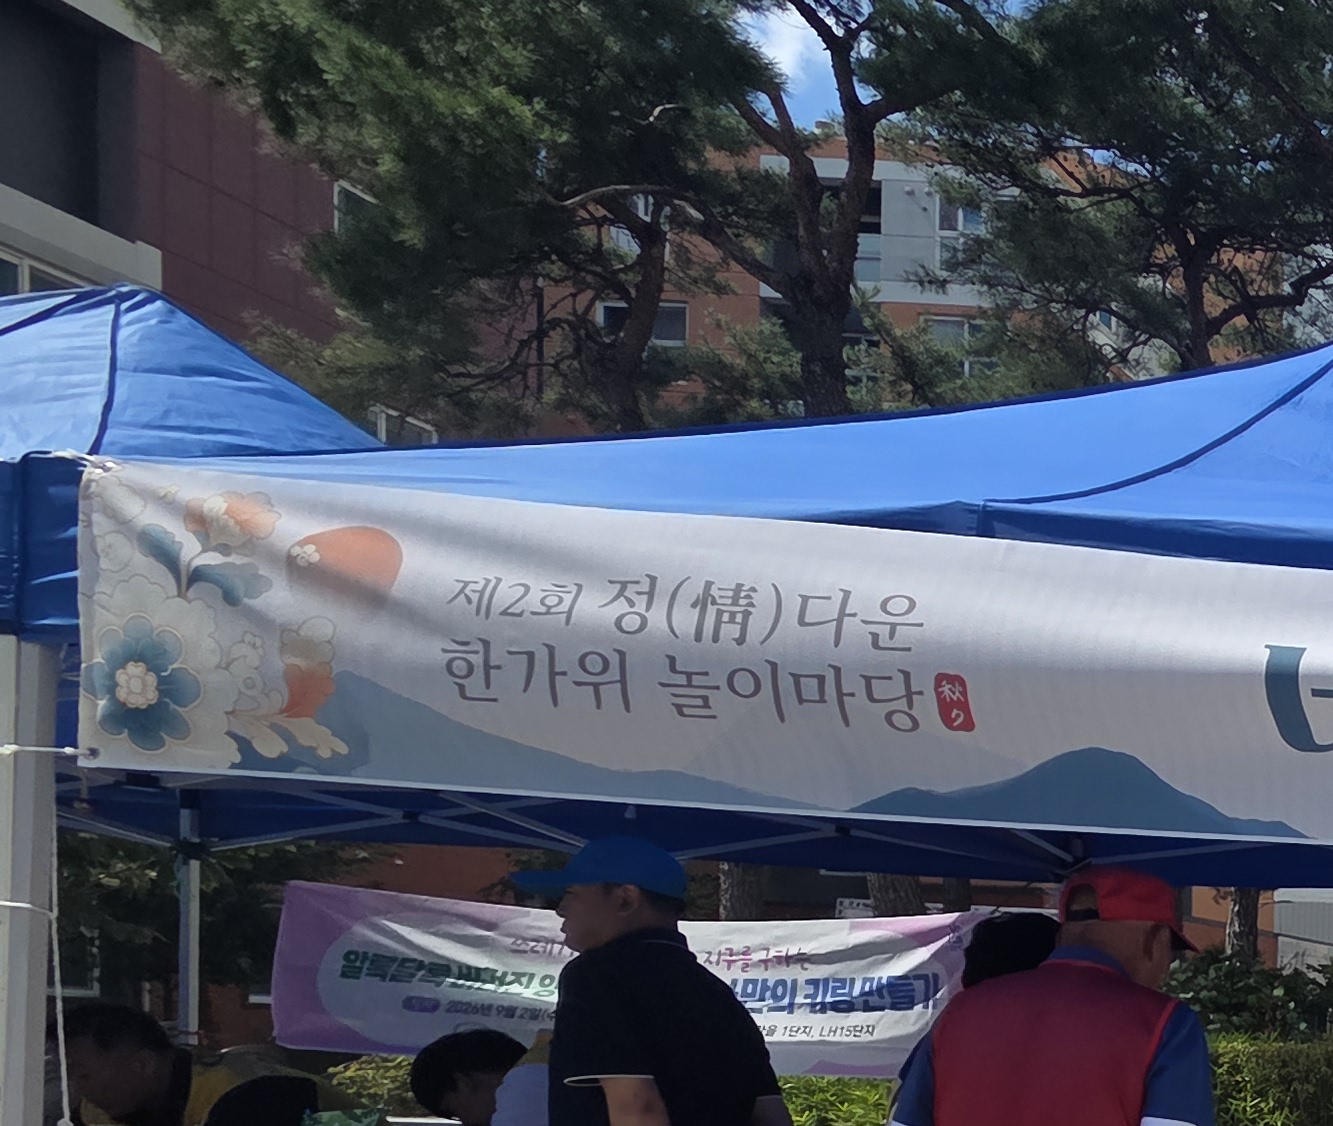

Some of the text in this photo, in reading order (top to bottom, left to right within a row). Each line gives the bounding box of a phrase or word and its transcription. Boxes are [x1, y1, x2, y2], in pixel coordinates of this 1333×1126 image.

[446, 575, 584, 626] 제2회
[440, 637, 925, 734] 한가위 놀이마당
[339, 949, 451, 988] 알록달록
[703, 945, 754, 974] 지구를
[818, 1023, 877, 1038] LH15단지
